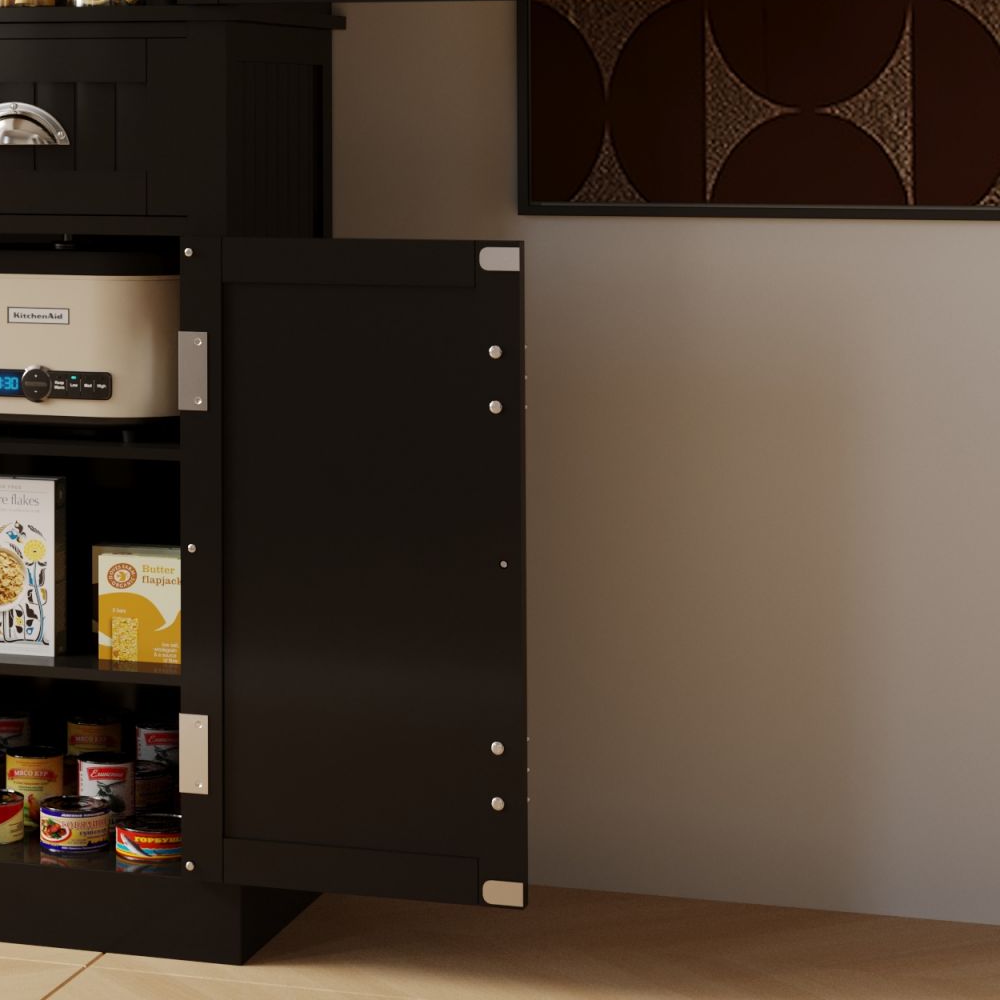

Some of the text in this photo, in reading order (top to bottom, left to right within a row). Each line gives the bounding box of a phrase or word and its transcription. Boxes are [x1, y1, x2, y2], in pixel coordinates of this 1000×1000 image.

[13, 311, 63, 320] KitchenAid
[11, 493, 40, 506] flakes
[142, 564, 176, 574] Butter
[14, 769, 33, 777] МЯСО
